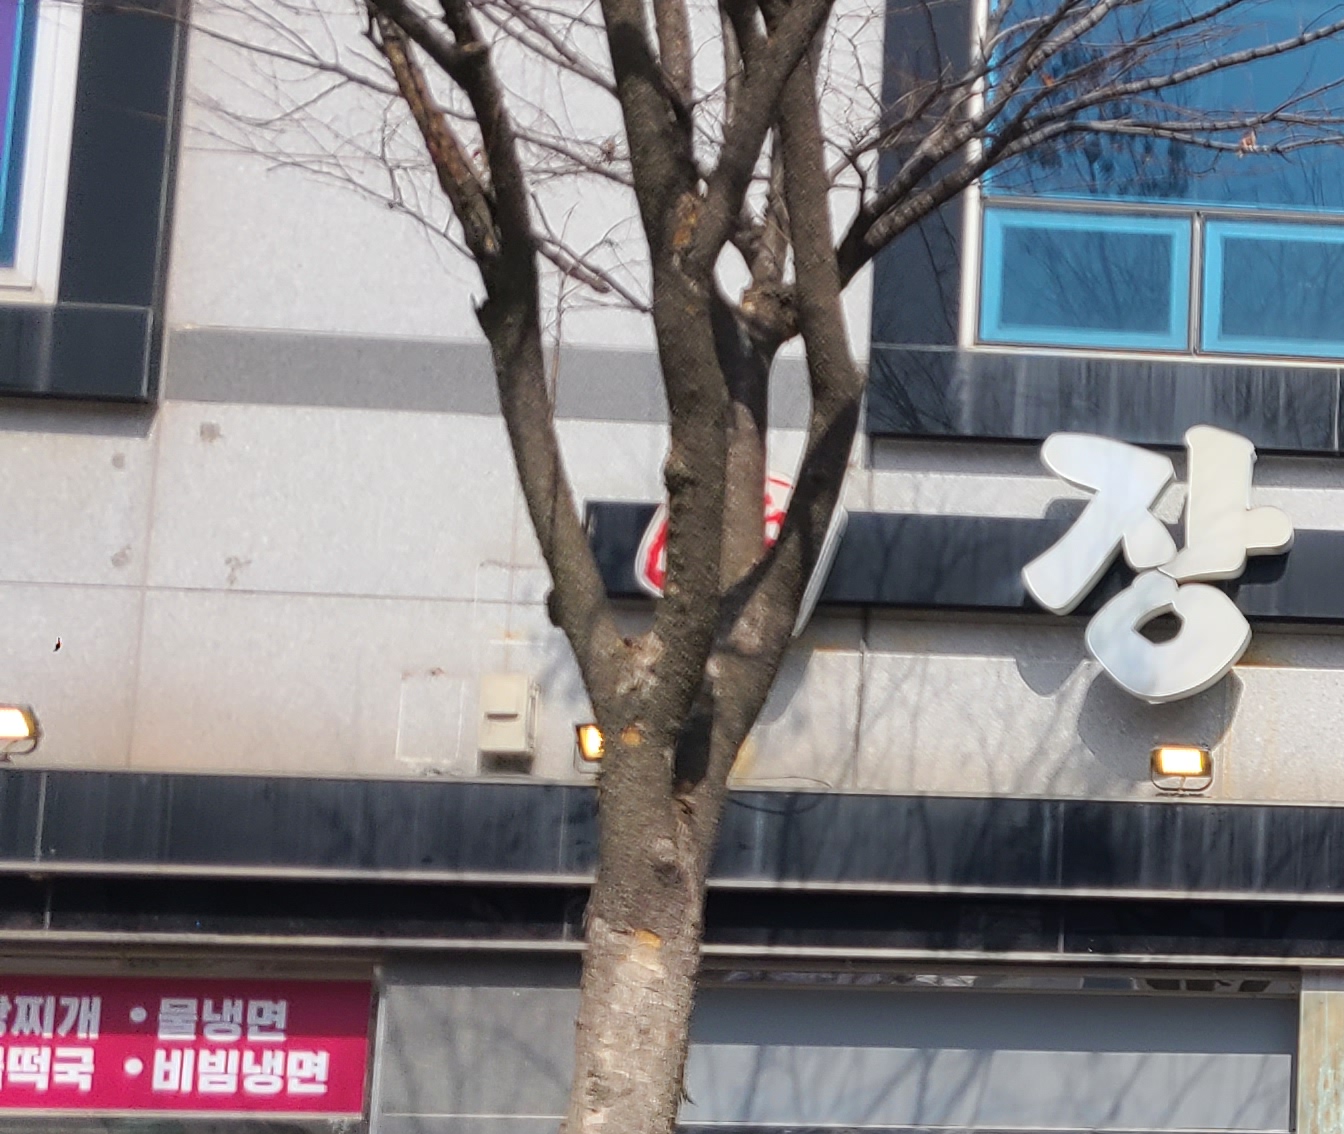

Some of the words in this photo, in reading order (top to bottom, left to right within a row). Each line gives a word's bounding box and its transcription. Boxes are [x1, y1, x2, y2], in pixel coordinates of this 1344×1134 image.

[0, 996, 101, 1041] 찌개
[157, 998, 288, 1041] 물냉면
[0, 1046, 95, 1091] 떡국
[152, 1048, 330, 1095] 비빔냉면
